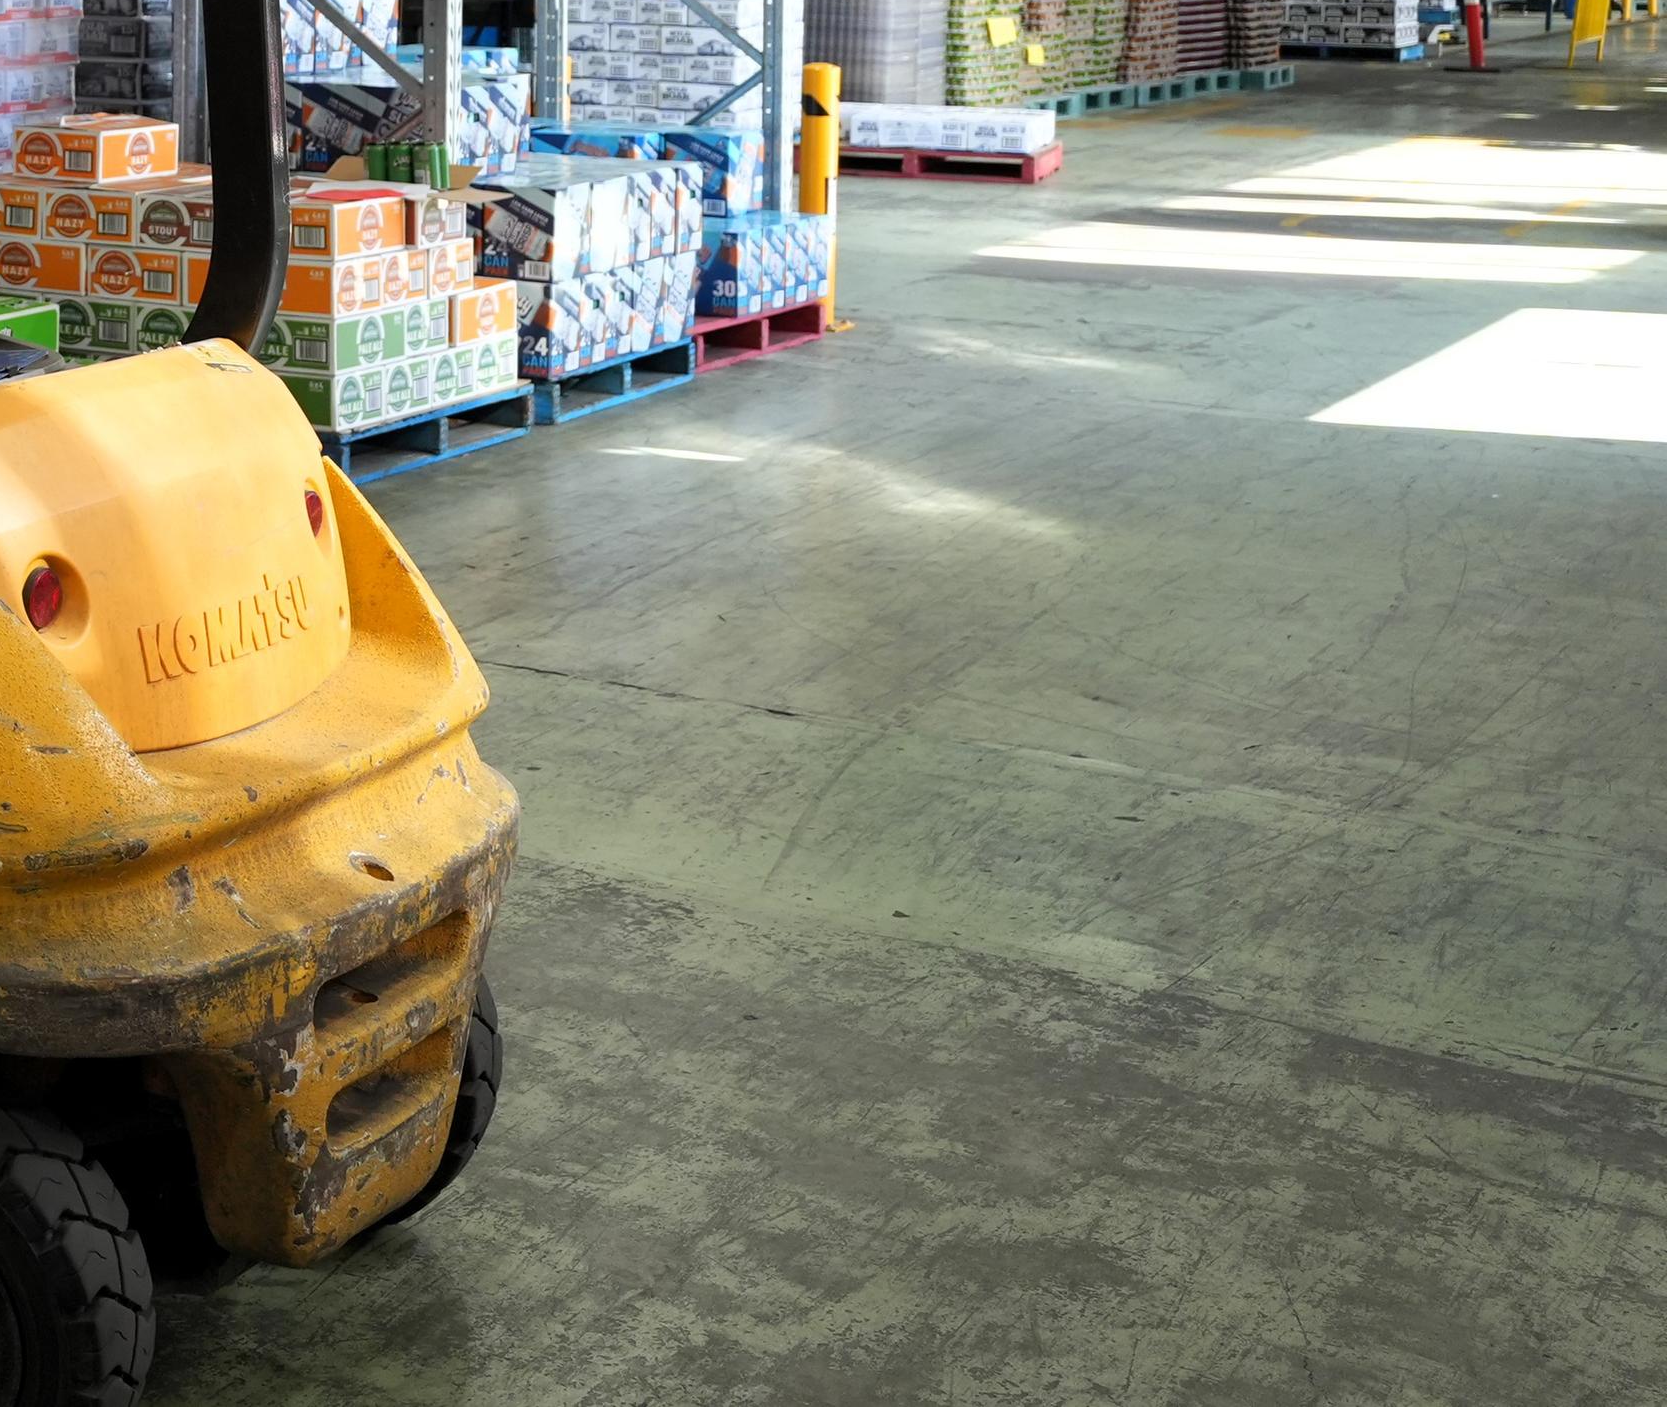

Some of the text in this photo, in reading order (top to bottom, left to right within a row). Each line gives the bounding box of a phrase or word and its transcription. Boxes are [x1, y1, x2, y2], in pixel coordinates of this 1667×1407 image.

[25, 154, 52, 166] HAZY
[56, 219, 85, 229] HAZY
[148, 226, 177, 236] STOUT
[484, 256, 509, 267] CAN
[2, 266, 30, 276] HAZY
[101, 275, 130, 285] HAZY
[712, 280, 736, 297] 30
[522, 336, 549, 356] 24
[136, 573, 315, 685] KOMATSU
